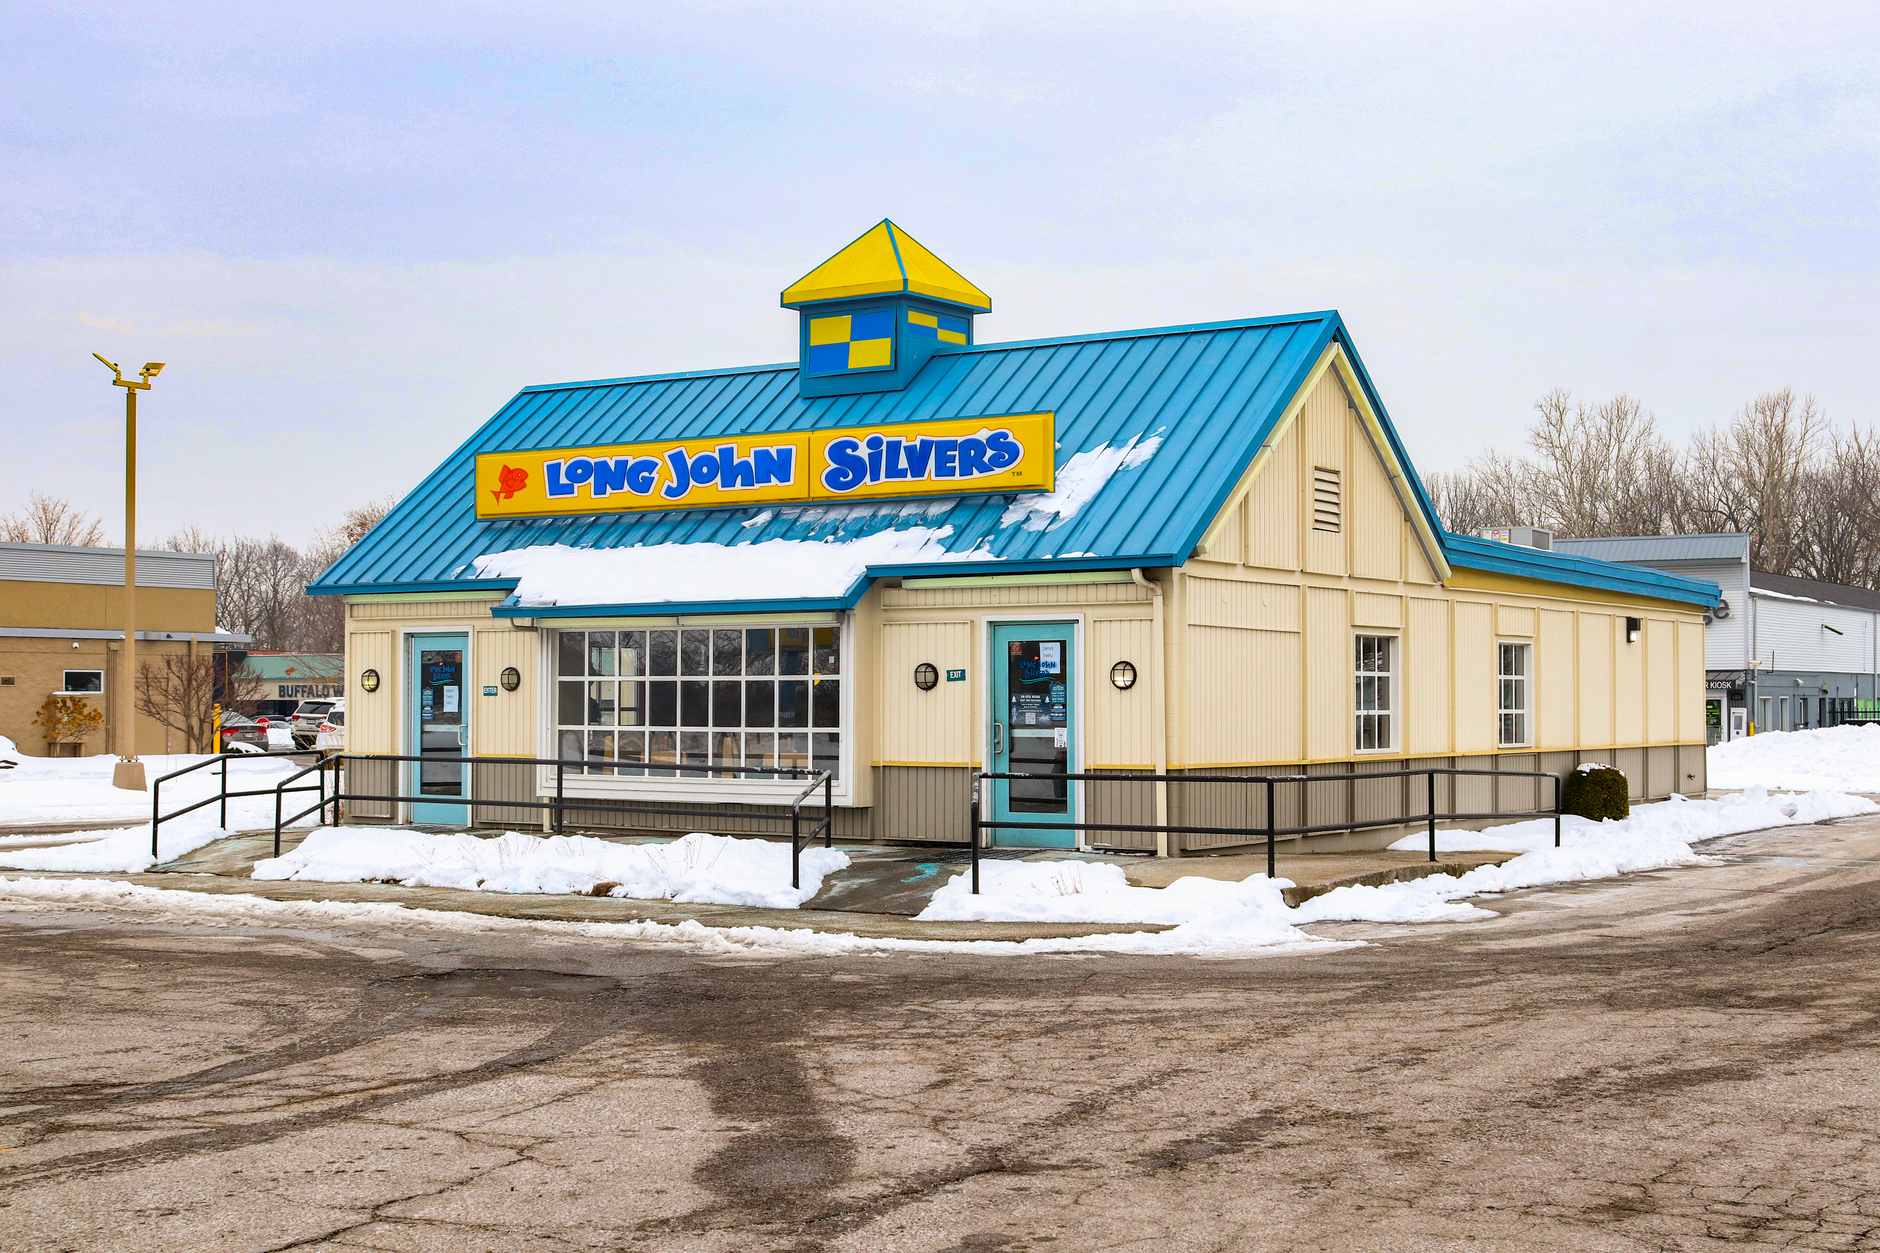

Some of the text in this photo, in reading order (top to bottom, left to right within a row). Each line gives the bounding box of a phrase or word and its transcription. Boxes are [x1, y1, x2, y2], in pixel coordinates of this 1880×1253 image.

[545, 457, 661, 497] LONG
[278, 684, 330, 698] BUFFALO
[1710, 681, 1732, 689] KIOSK
